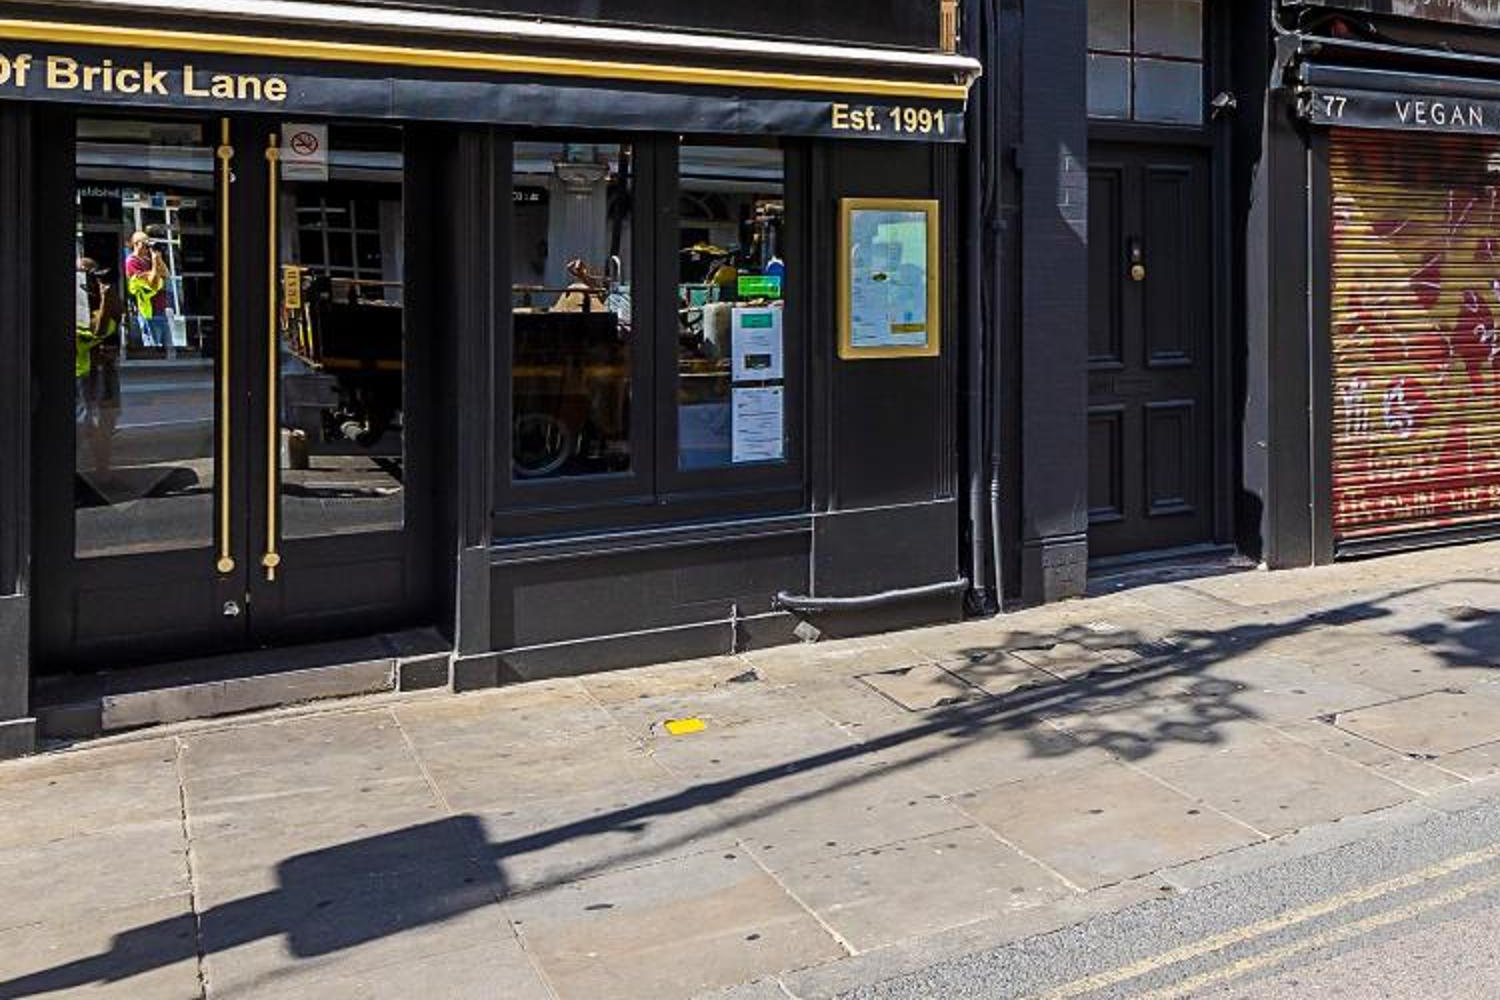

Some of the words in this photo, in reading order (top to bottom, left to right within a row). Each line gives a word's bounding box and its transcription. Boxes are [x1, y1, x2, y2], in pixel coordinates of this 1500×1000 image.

[46, 55, 170, 97] Brick
[183, 64, 289, 102] Lane
[831, 102, 881, 132] Est.
[888, 105, 945, 134] 1991
[1322, 95, 1348, 118] 77
[1394, 99, 1484, 128] VEGAN
